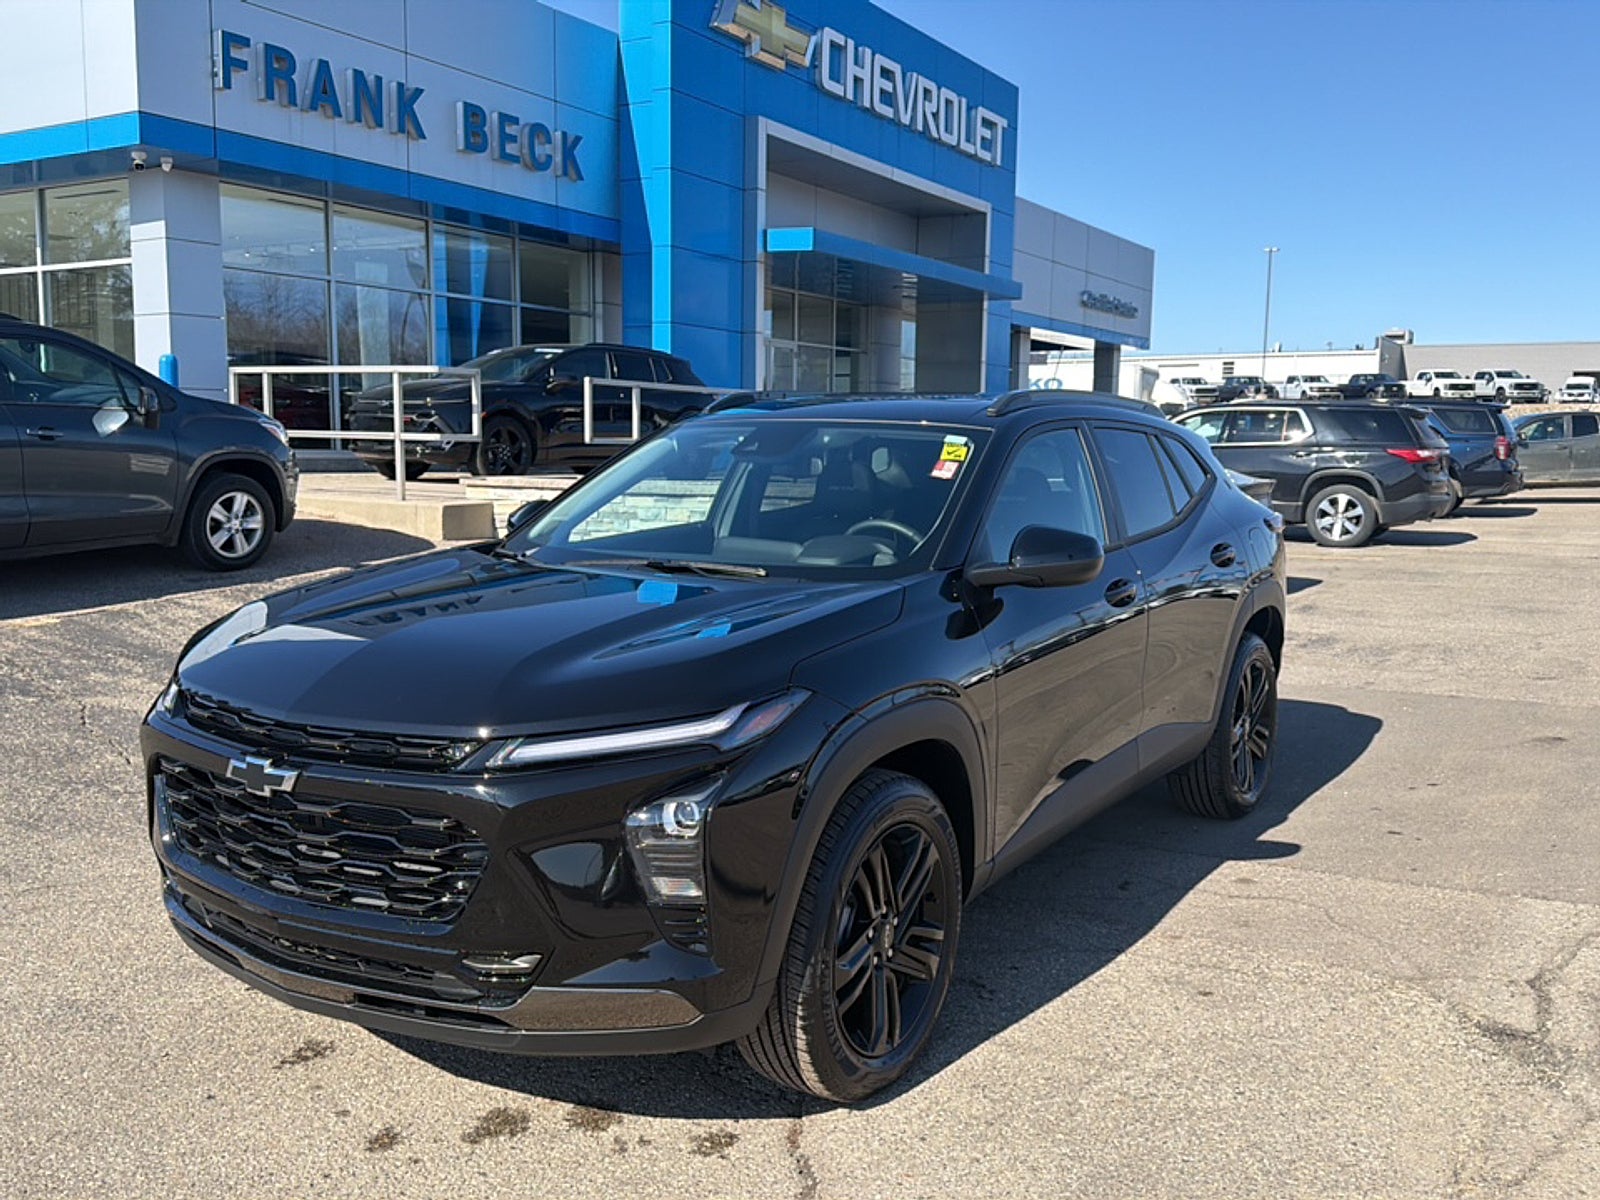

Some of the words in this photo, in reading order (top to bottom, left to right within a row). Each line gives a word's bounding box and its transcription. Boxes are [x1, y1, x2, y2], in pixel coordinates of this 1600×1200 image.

[214, 29, 427, 139] FRANK
[456, 101, 584, 181] BECK
[818, 27, 1008, 165] CHEVROLET
